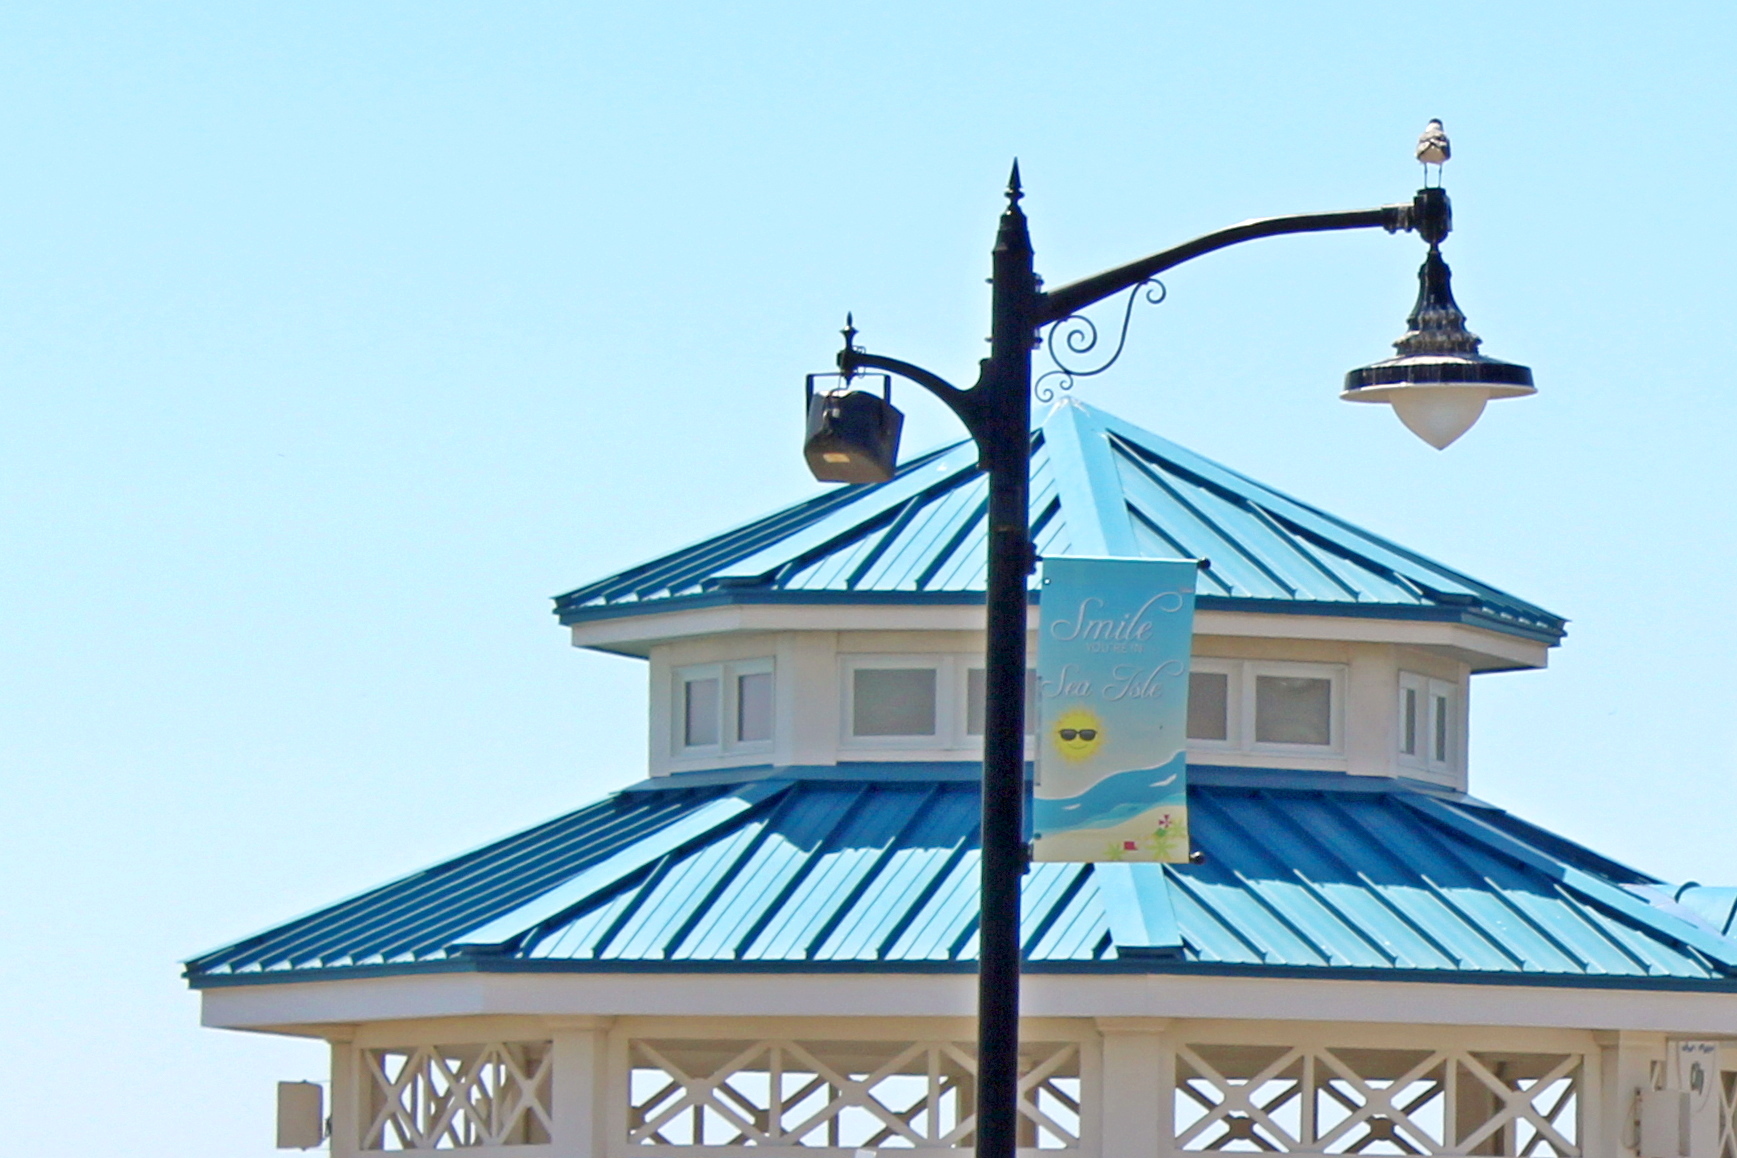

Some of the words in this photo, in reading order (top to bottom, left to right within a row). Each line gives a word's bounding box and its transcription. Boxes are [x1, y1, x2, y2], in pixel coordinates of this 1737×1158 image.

[1050, 591, 1184, 641] Smile
[1130, 642, 1144, 654] IN
[1041, 663, 1093, 700] Sea
[1102, 659, 1184, 702] Isle
